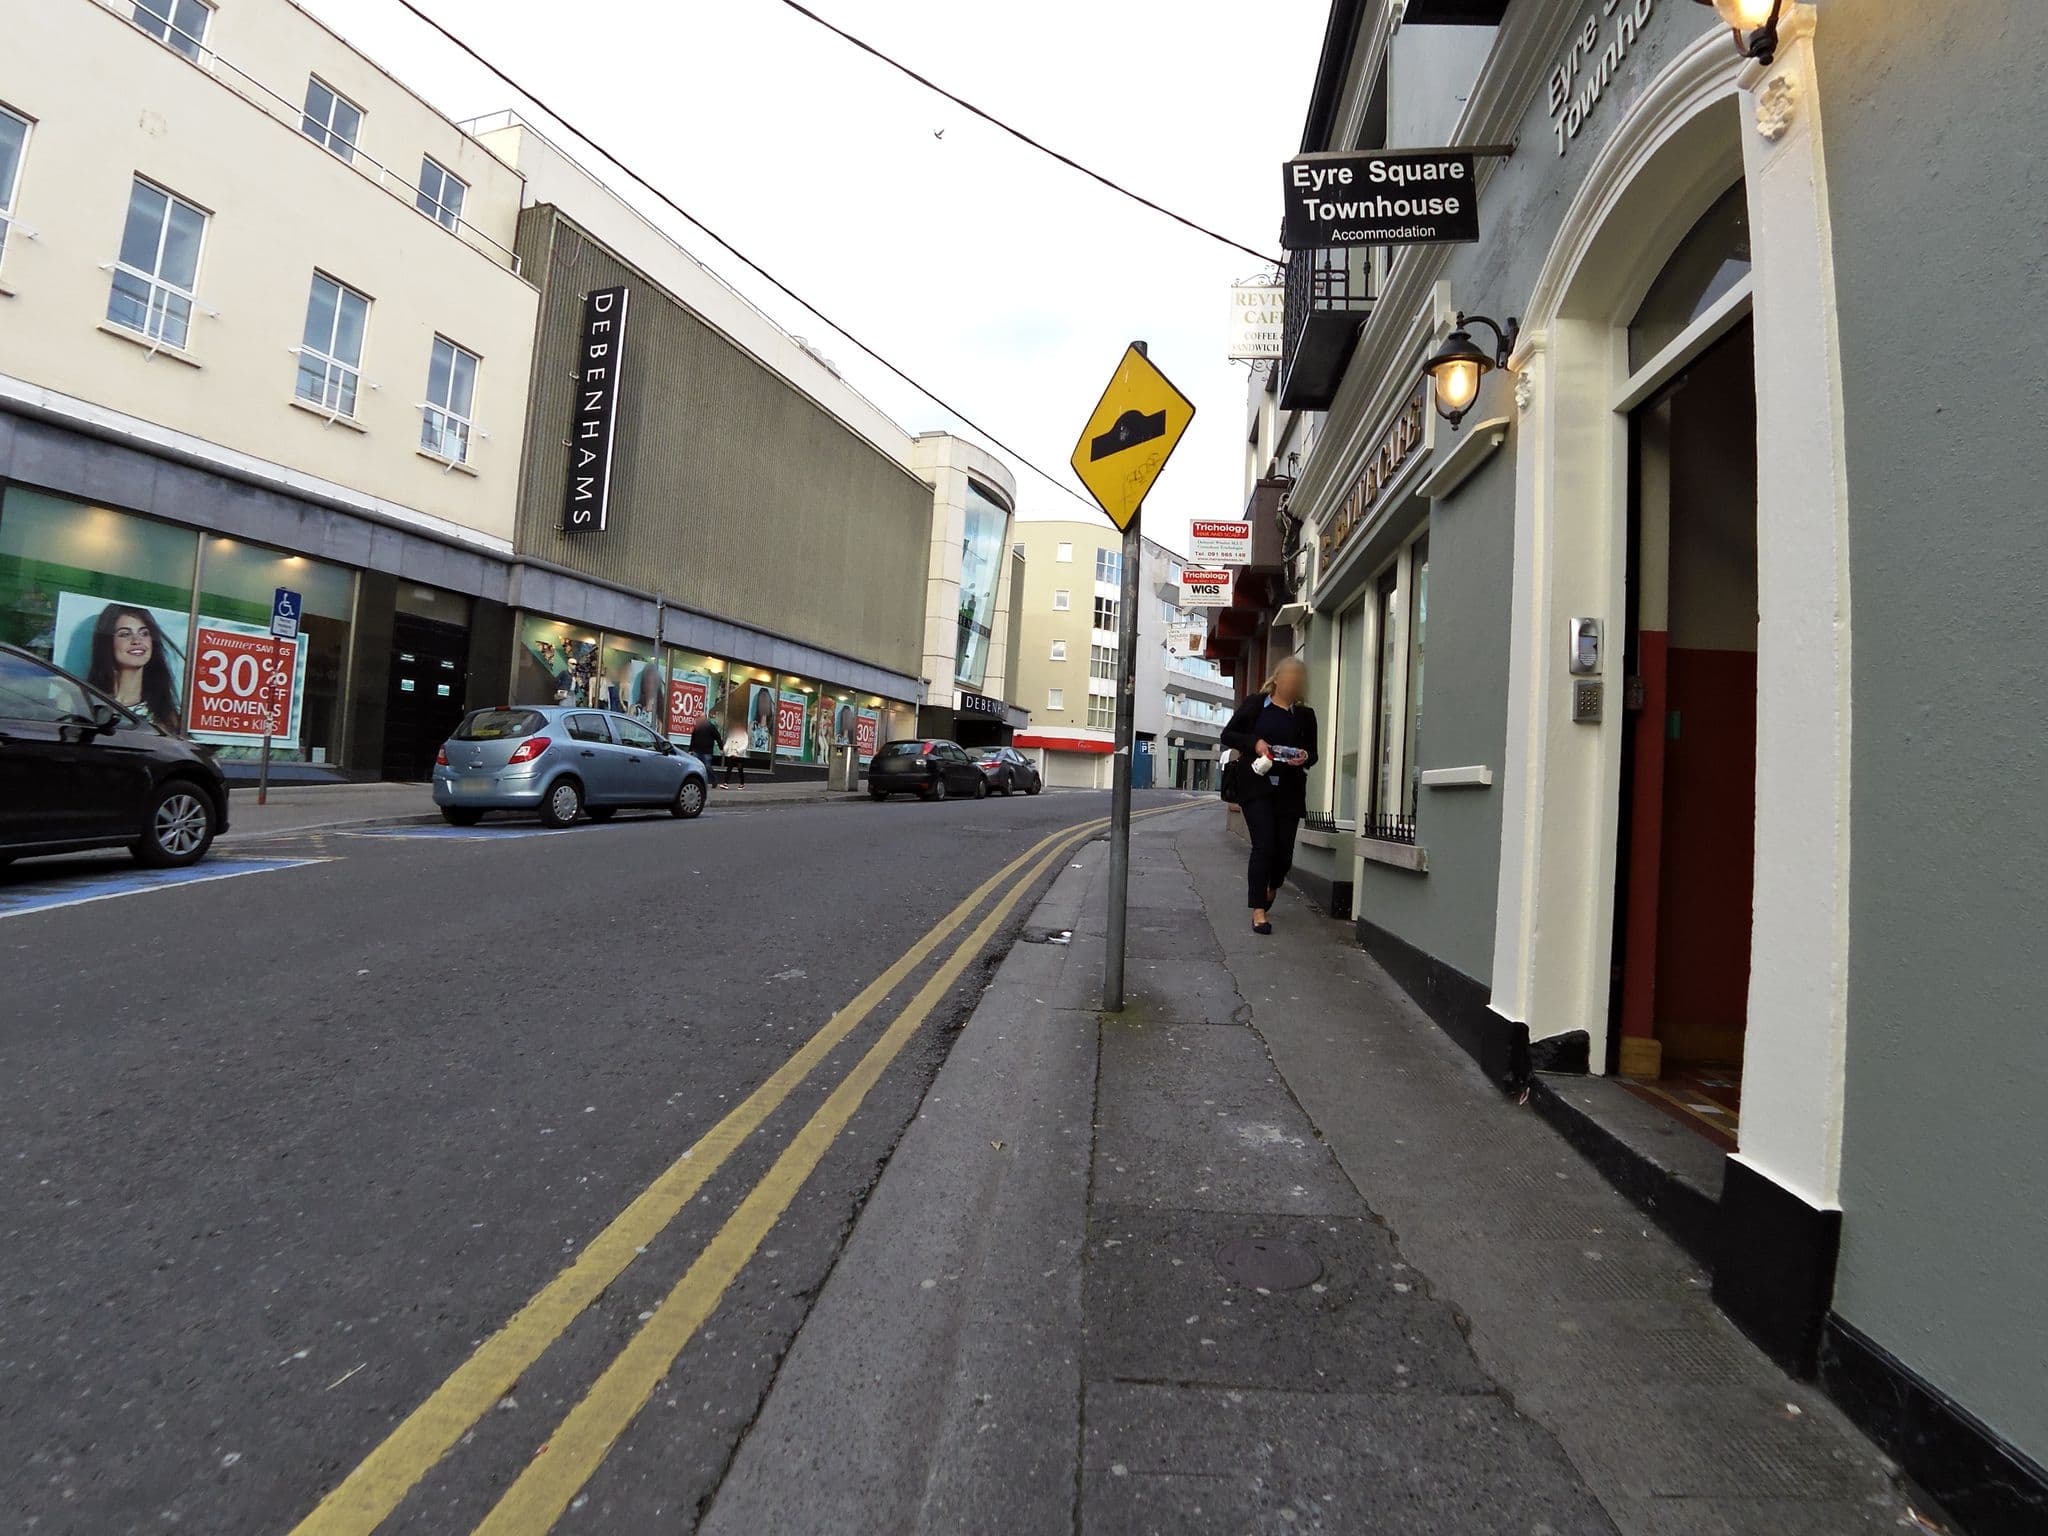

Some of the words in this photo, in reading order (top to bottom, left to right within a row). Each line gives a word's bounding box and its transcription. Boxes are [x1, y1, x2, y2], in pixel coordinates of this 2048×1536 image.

[1549, 14, 1598, 117] Eyre
[1554, 0, 1654, 156] Townho
[1292, 164, 1353, 191] Eyre
[1369, 160, 1464, 187] Square
[1303, 196, 1460, 221] Townhouse
[1331, 225, 1436, 241] Accommodation
[1236, 293, 1285, 306] REVIV
[1244, 332, 1278, 340] COFFEE
[573, 293, 614, 524] DEBENHAMS
[1195, 523, 1248, 534] Trichology
[1184, 572, 1228, 580] Trichology
[1191, 585, 1220, 594] WIGS
[203, 632, 255, 650] Summer
[256, 643, 290, 656] SAVIGS
[202, 696, 282, 717] WOMENS
[200, 715, 240, 729] MEN'S
